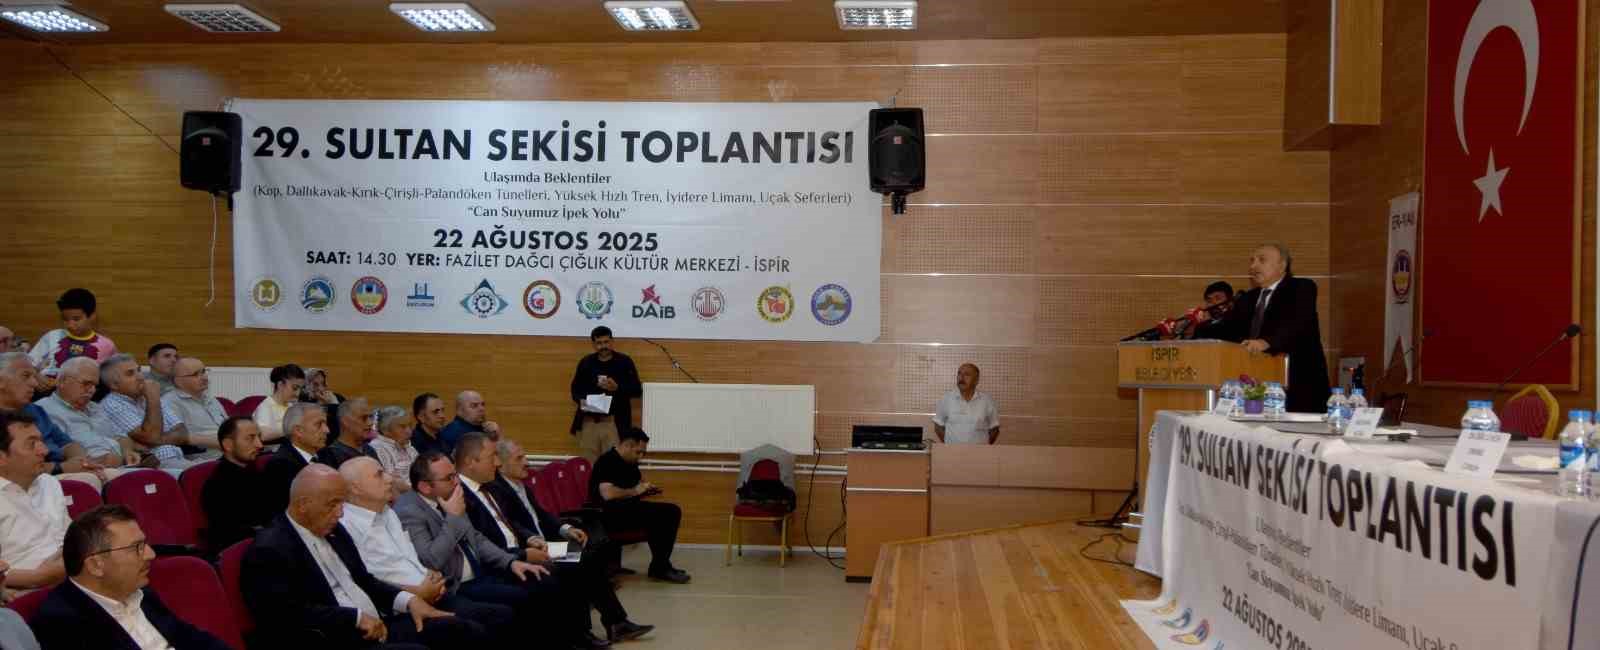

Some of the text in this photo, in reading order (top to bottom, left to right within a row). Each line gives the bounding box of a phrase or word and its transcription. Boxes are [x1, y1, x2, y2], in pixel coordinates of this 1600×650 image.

[252, 119, 854, 164] 29. SULTAN SEKİSİ TOPLANTISI
[484, 171, 612, 185] Ulaşımda Beklentiler
[554, 189, 597, 202] Yüksek
[600, 190, 628, 202] Hızlı
[760, 191, 790, 205] Uçak
[794, 191, 852, 206] Seferleri)
[501, 206, 559, 220] Suyumuz
[562, 205, 589, 221] İpek
[433, 224, 659, 251] 22 AĞUSTOS 2025
[306, 250, 351, 265] SAAT:
[357, 251, 398, 266] 14.30
[406, 252, 440, 267] YER:
[445, 250, 500, 268] FAZİLET
[505, 251, 554, 269] DAĞCI
[559, 252, 608, 272] ÇIĞLIK
[614, 253, 669, 271] KÜLTÜR
[674, 255, 741, 272] MERKEZİ
[754, 255, 791, 273] İSPİR
[1179, 425, 1195, 469] 29.
[1197, 430, 1251, 490] SULTAN
[1318, 459, 1517, 588] TOPLANTISI
[1234, 592, 1283, 650] AĞUSTOS
[1286, 630, 1313, 650] 20
